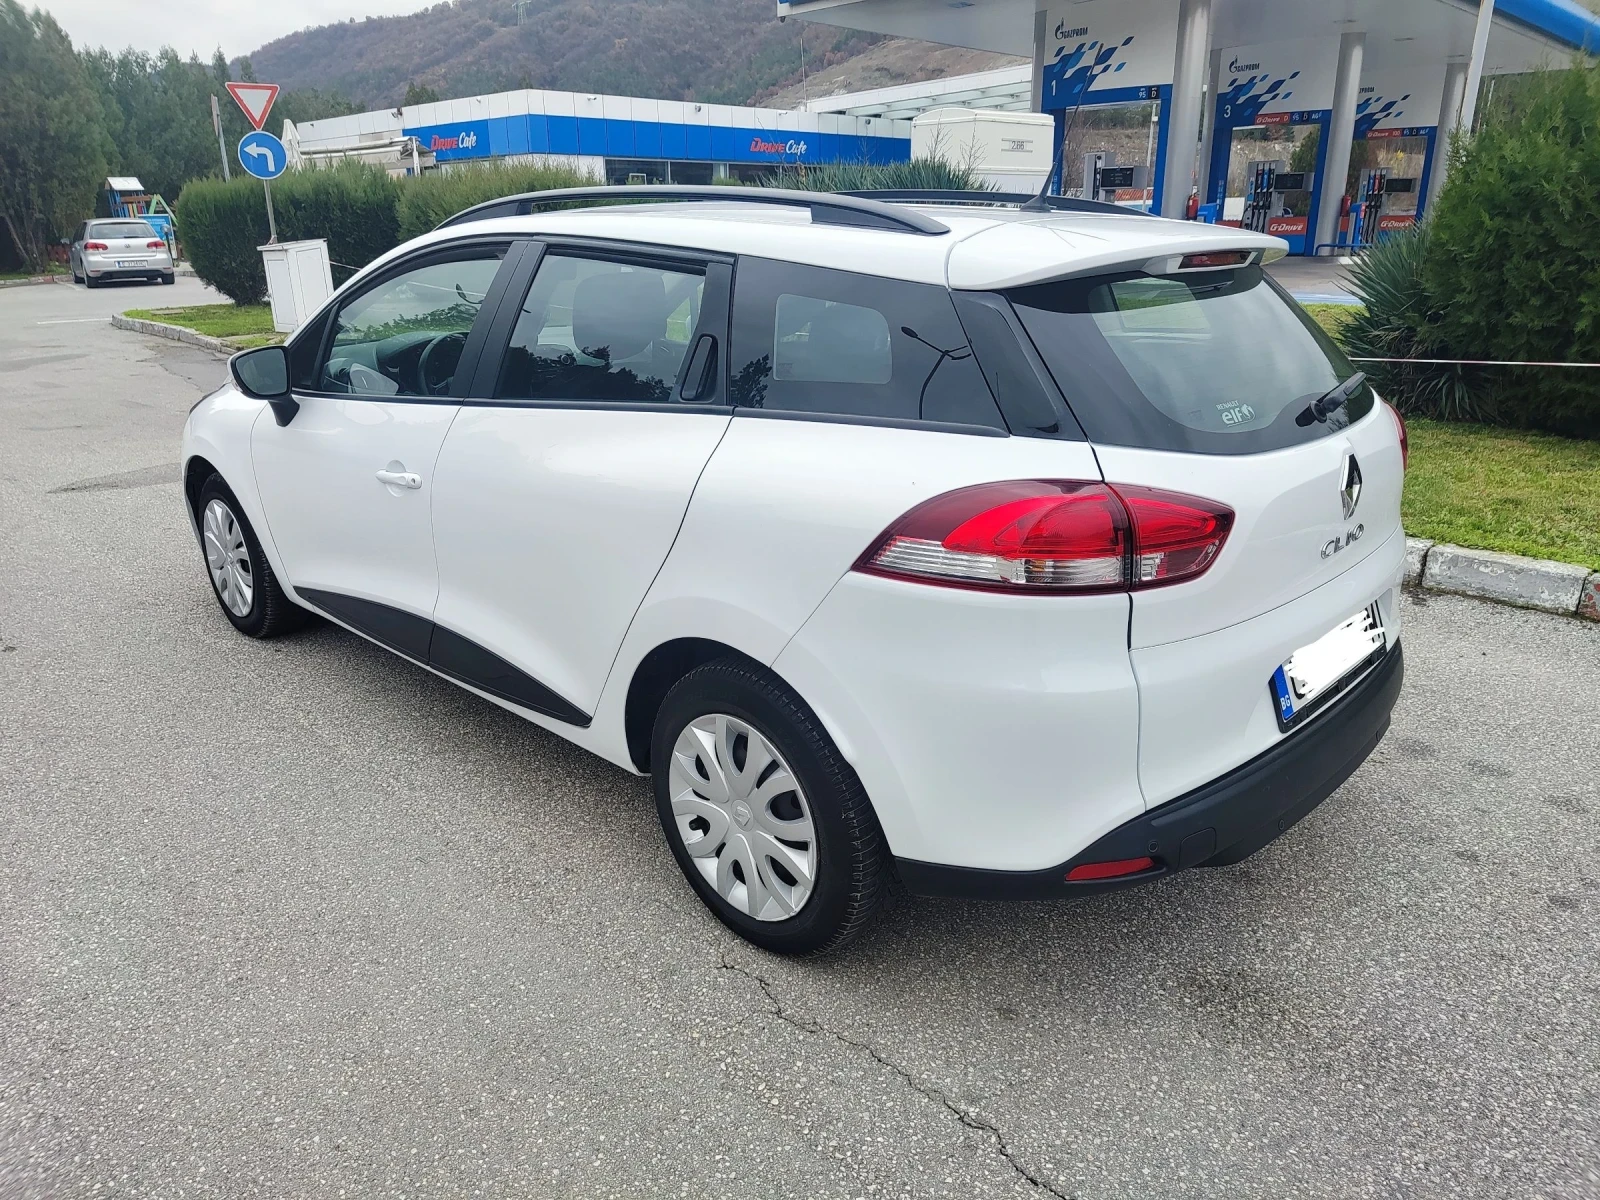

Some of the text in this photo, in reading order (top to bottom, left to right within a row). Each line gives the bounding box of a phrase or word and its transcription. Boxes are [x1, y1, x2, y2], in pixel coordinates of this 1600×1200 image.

[1051, 79, 1057, 97] 1
[1224, 105, 1231, 118] 3
[431, 131, 477, 151] DRIVE Cafe
[750, 138, 807, 155] DRIVE Cafe
[1215, 400, 1240, 410] RENAULT
[1221, 407, 1243, 424] elf
[1321, 523, 1365, 559] CLIO
[1280, 694, 1292, 711] BG
